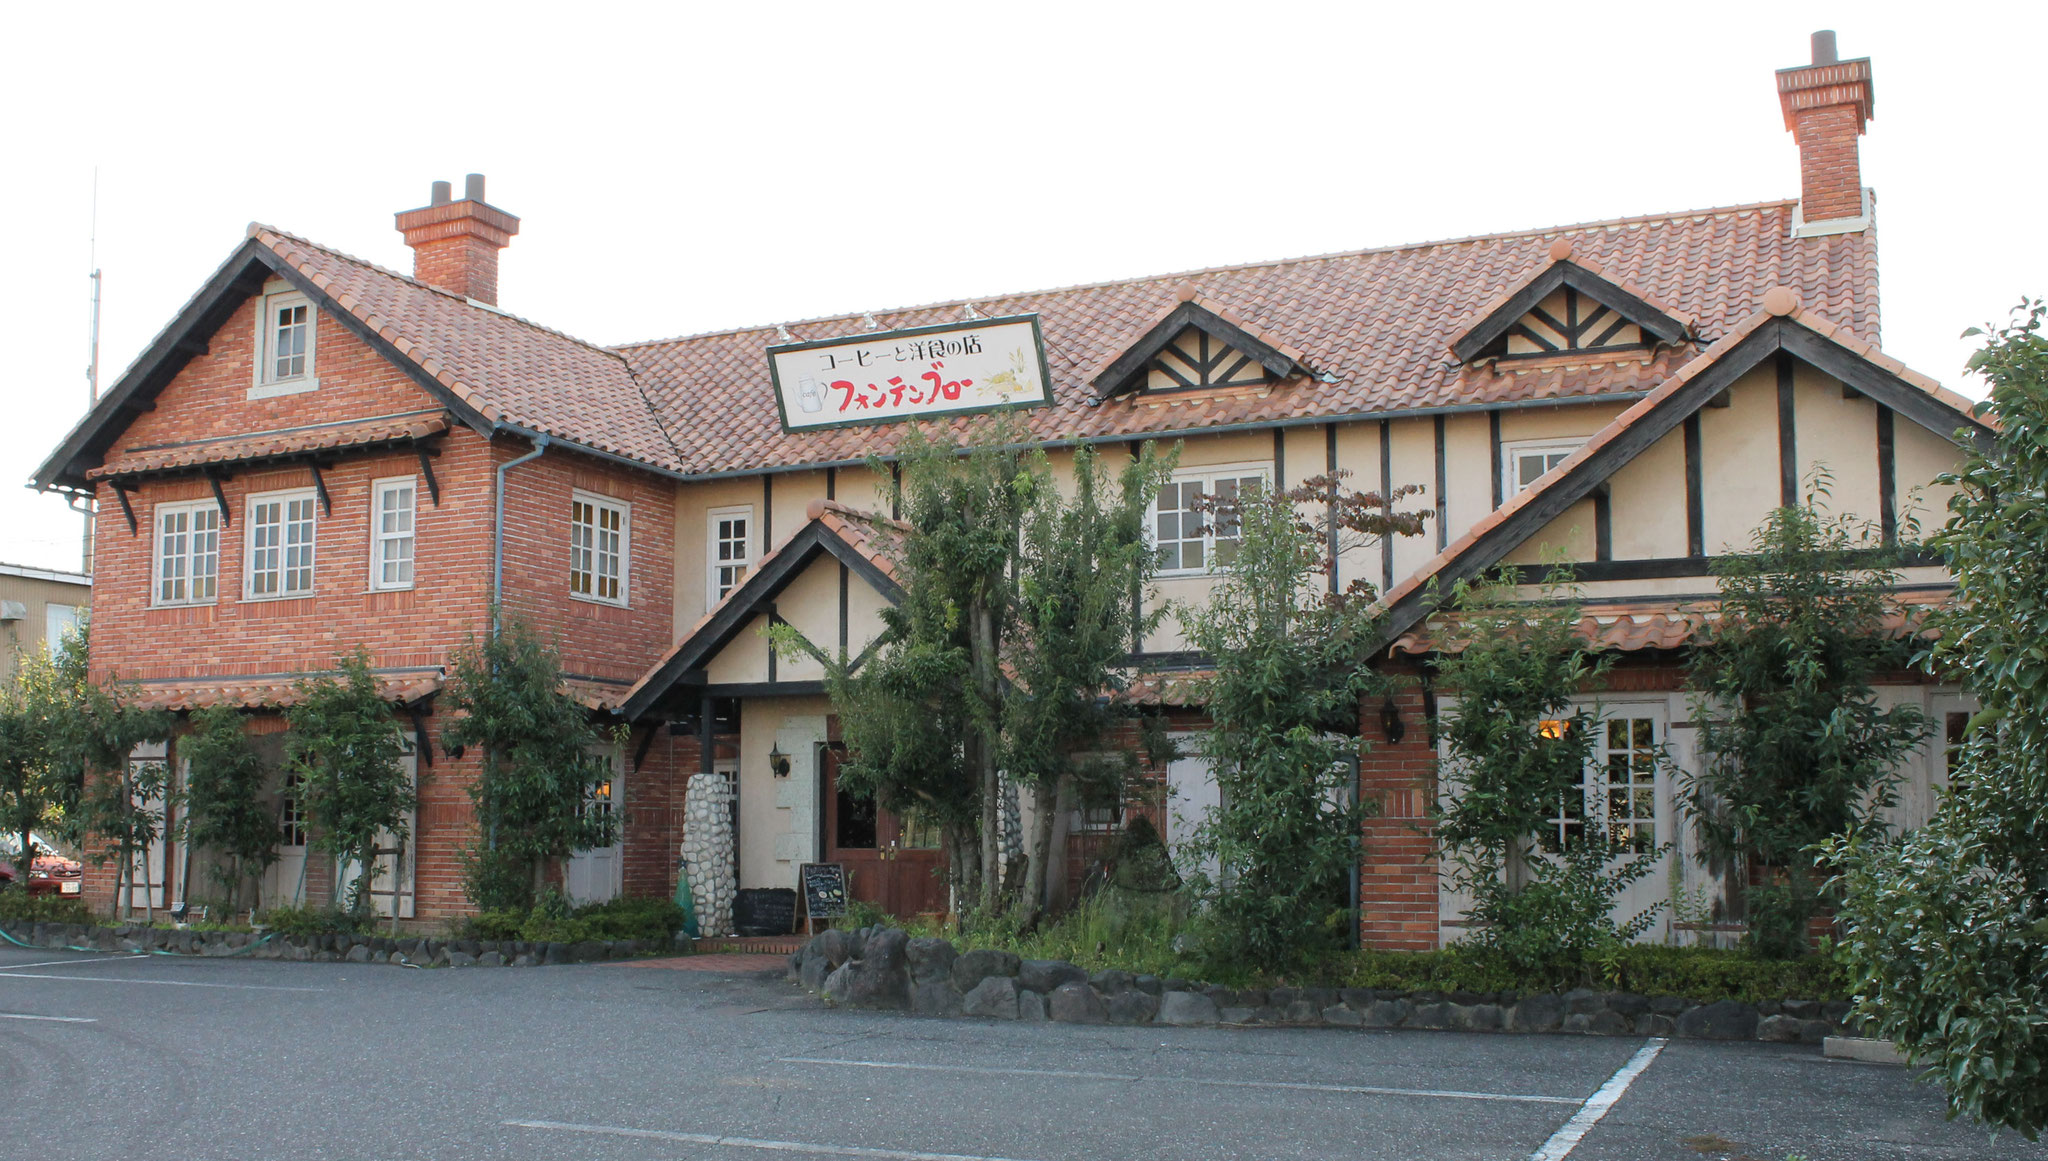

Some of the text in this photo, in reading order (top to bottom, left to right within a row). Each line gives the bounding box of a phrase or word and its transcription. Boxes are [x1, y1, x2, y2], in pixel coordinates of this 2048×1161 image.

[819, 334, 982, 371] コーヒーと洋食の店
[830, 361, 973, 413] フォンテンブロー
